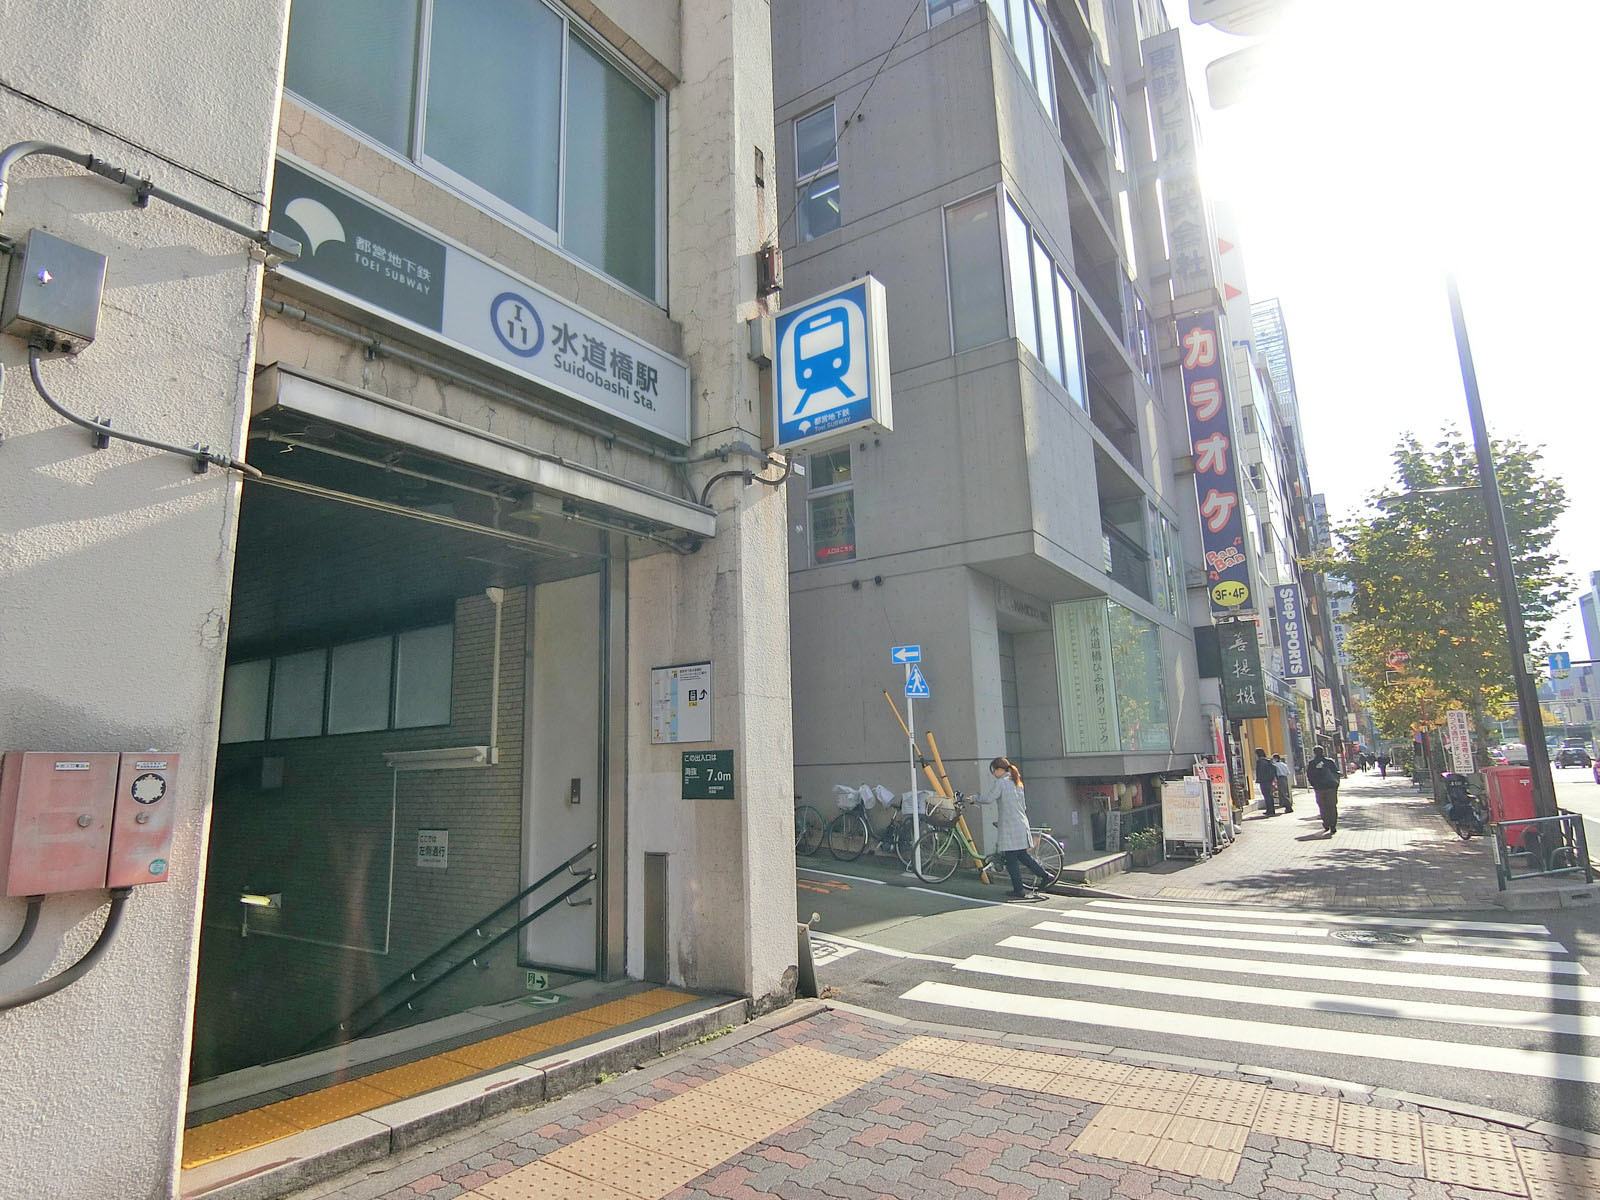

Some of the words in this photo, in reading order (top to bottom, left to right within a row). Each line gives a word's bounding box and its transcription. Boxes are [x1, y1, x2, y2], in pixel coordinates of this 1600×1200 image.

[355, 236, 431, 282] 都営地下鉄
[355, 253, 380, 272] TOEI
[384, 267, 430, 295] SUBWAY
[507, 319, 528, 345] 11
[552, 322, 658, 396] 水道橋駅
[553, 353, 630, 400] Suidobashi
[633, 390, 657, 412] Sta.
[814, 408, 850, 426] 都営地下鉄
[1182, 327, 1239, 533] カラオケ
[1205, 546, 1238, 565] Ban
[1213, 552, 1246, 573] Ban
[1279, 588, 1296, 619] Step
[1284, 621, 1304, 675] SPORTS
[1089, 626, 1109, 744] 水道橋ひふ科クリニック
[1228, 632, 1257, 705] 菩提樹
[684, 753, 717, 762] この出入口は
[706, 768, 732, 782] 7.0m
[419, 845, 446, 857] 左側通行
